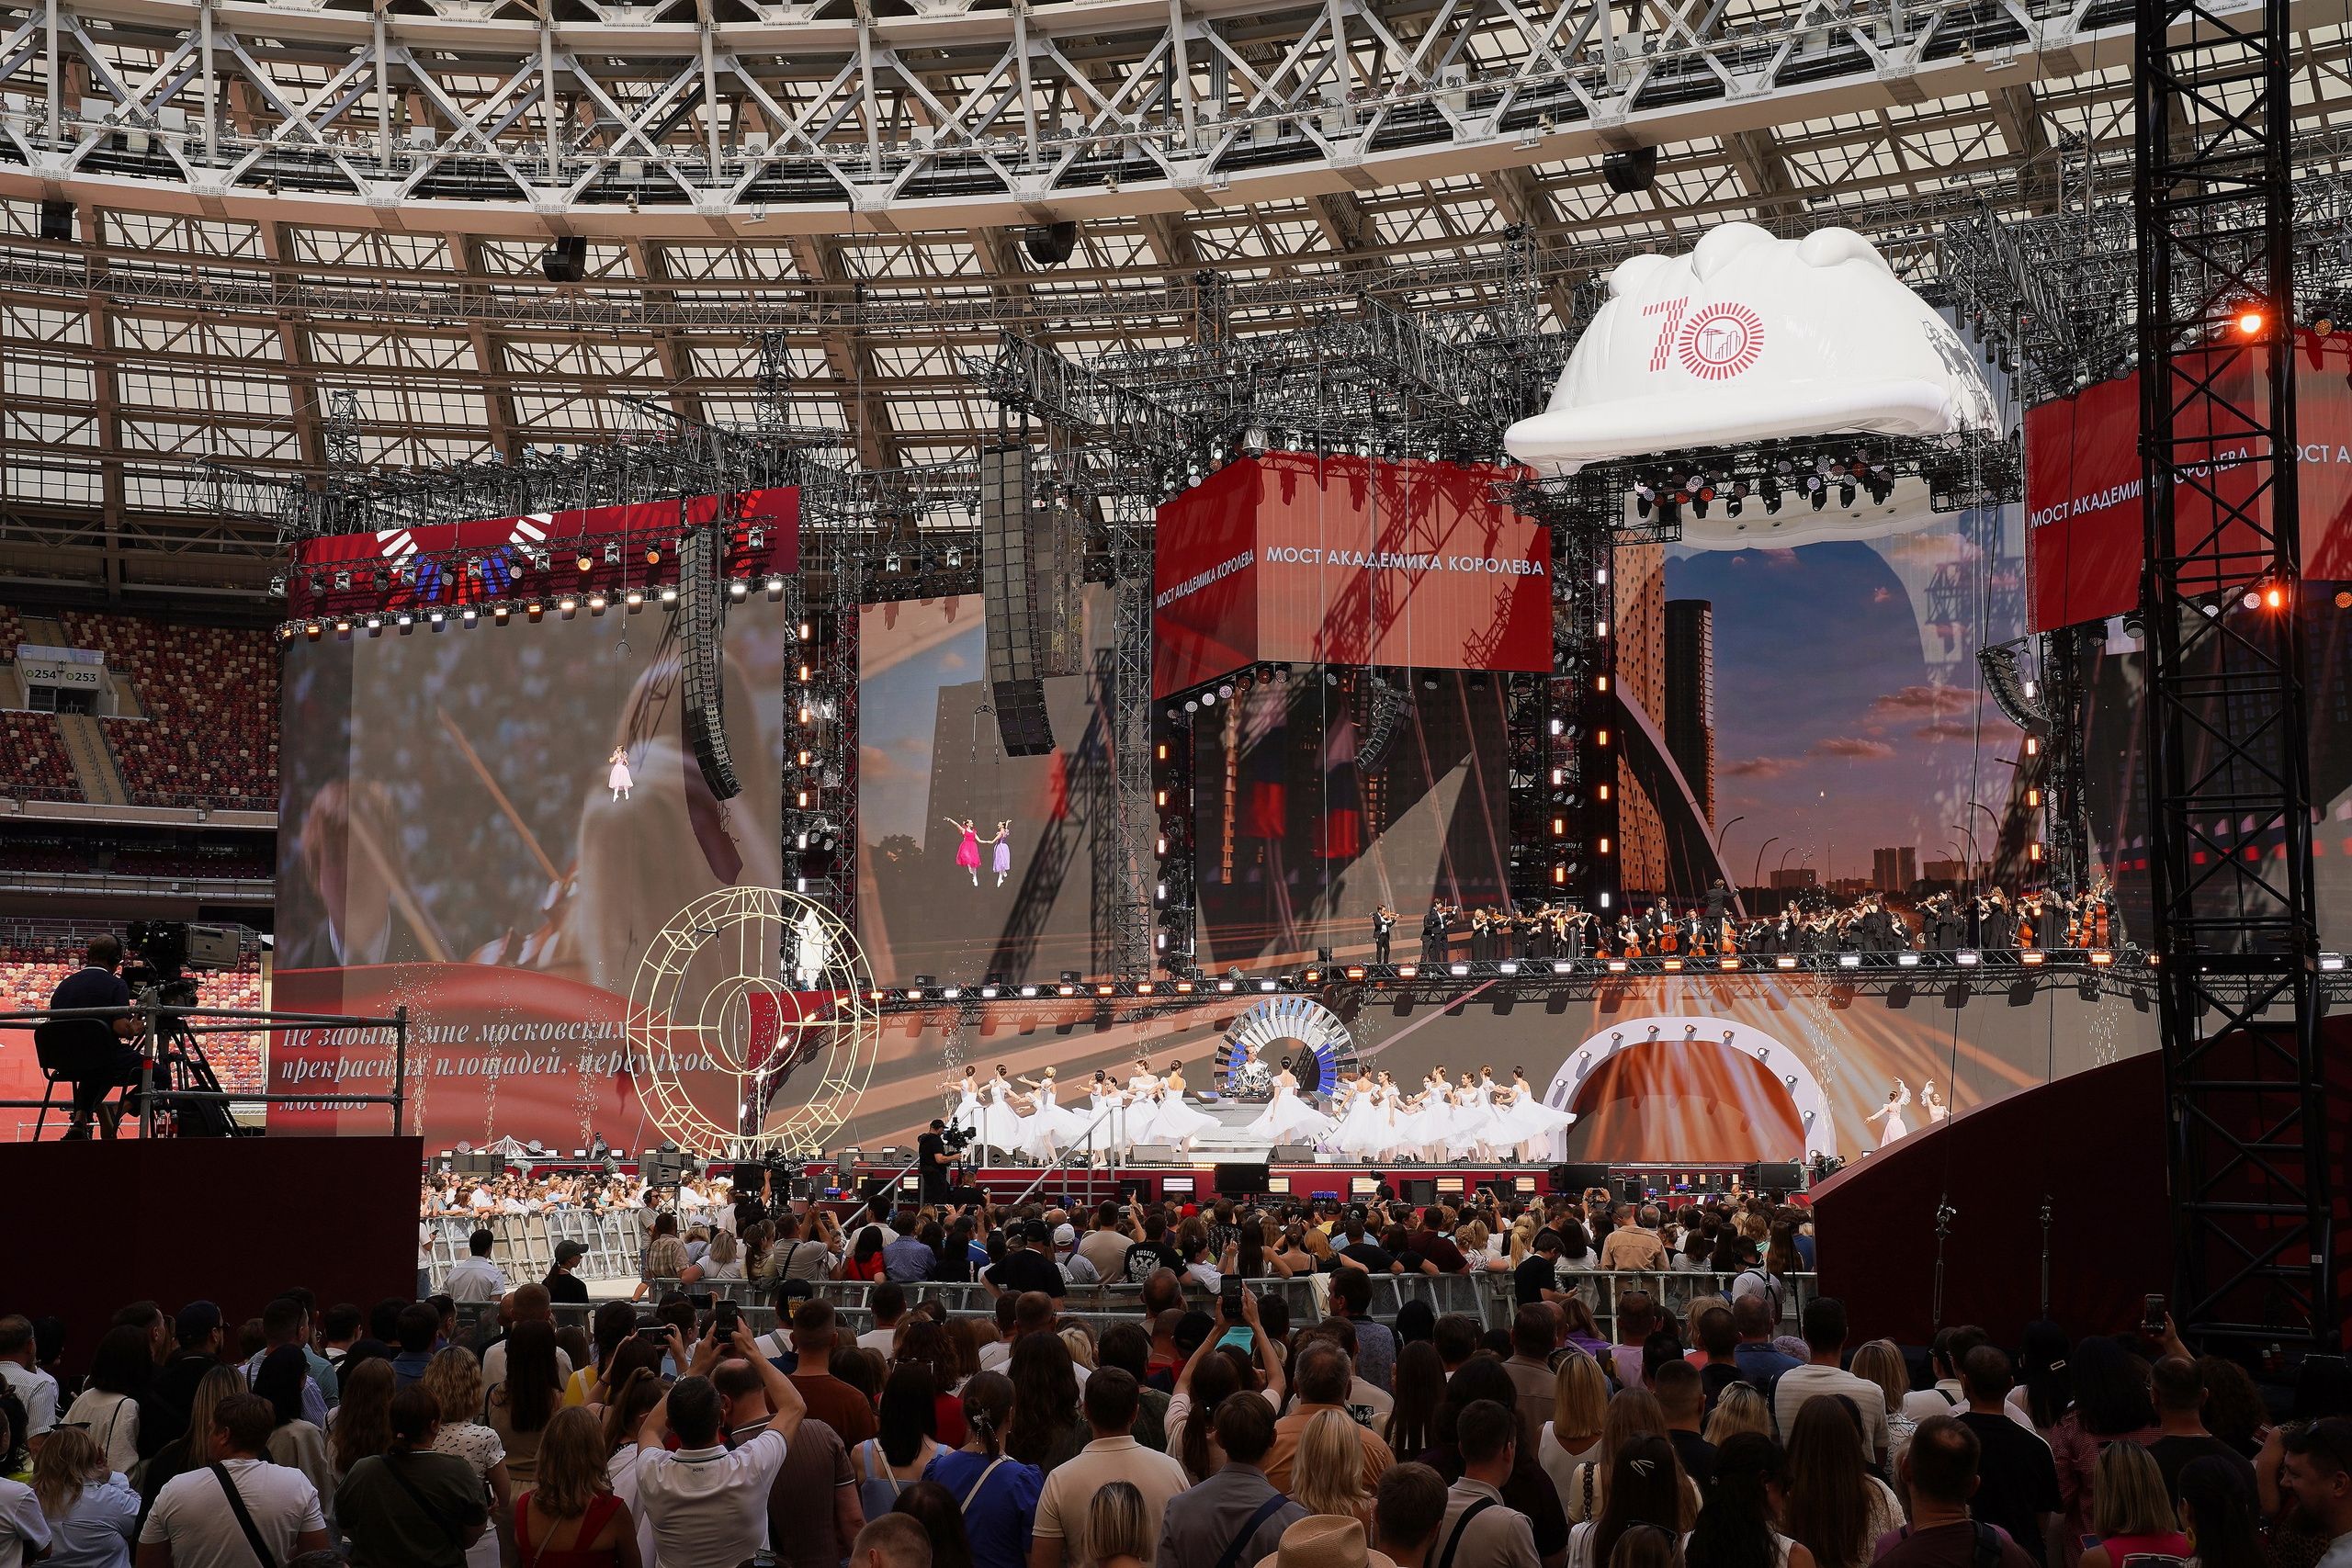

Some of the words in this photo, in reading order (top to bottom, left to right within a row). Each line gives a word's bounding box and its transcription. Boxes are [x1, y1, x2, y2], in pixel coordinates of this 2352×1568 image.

[2030, 502, 2069, 529] МОСТ
[2072, 474, 2158, 516] АКАДЕМИ
[2173, 446, 2248, 484] ОРОЛЕВА
[1266, 547, 1321, 564] МОСТ
[1327, 549, 1442, 570] АКАДЕМИКА
[1449, 556, 1544, 576] КОРОЛЕВА
[1156, 587, 1174, 609] МОСТ
[1175, 568, 1216, 599] АКАДЕМИКА
[1217, 548, 1254, 579] КОРОЛЕВА
[34, 669, 57, 680] 254
[74, 672, 96, 682] 253
[475, 1021, 627, 1043] московских
[435, 1046, 567, 1079] площадей,
[1136, 1249, 1157, 1258] RUSSIA
